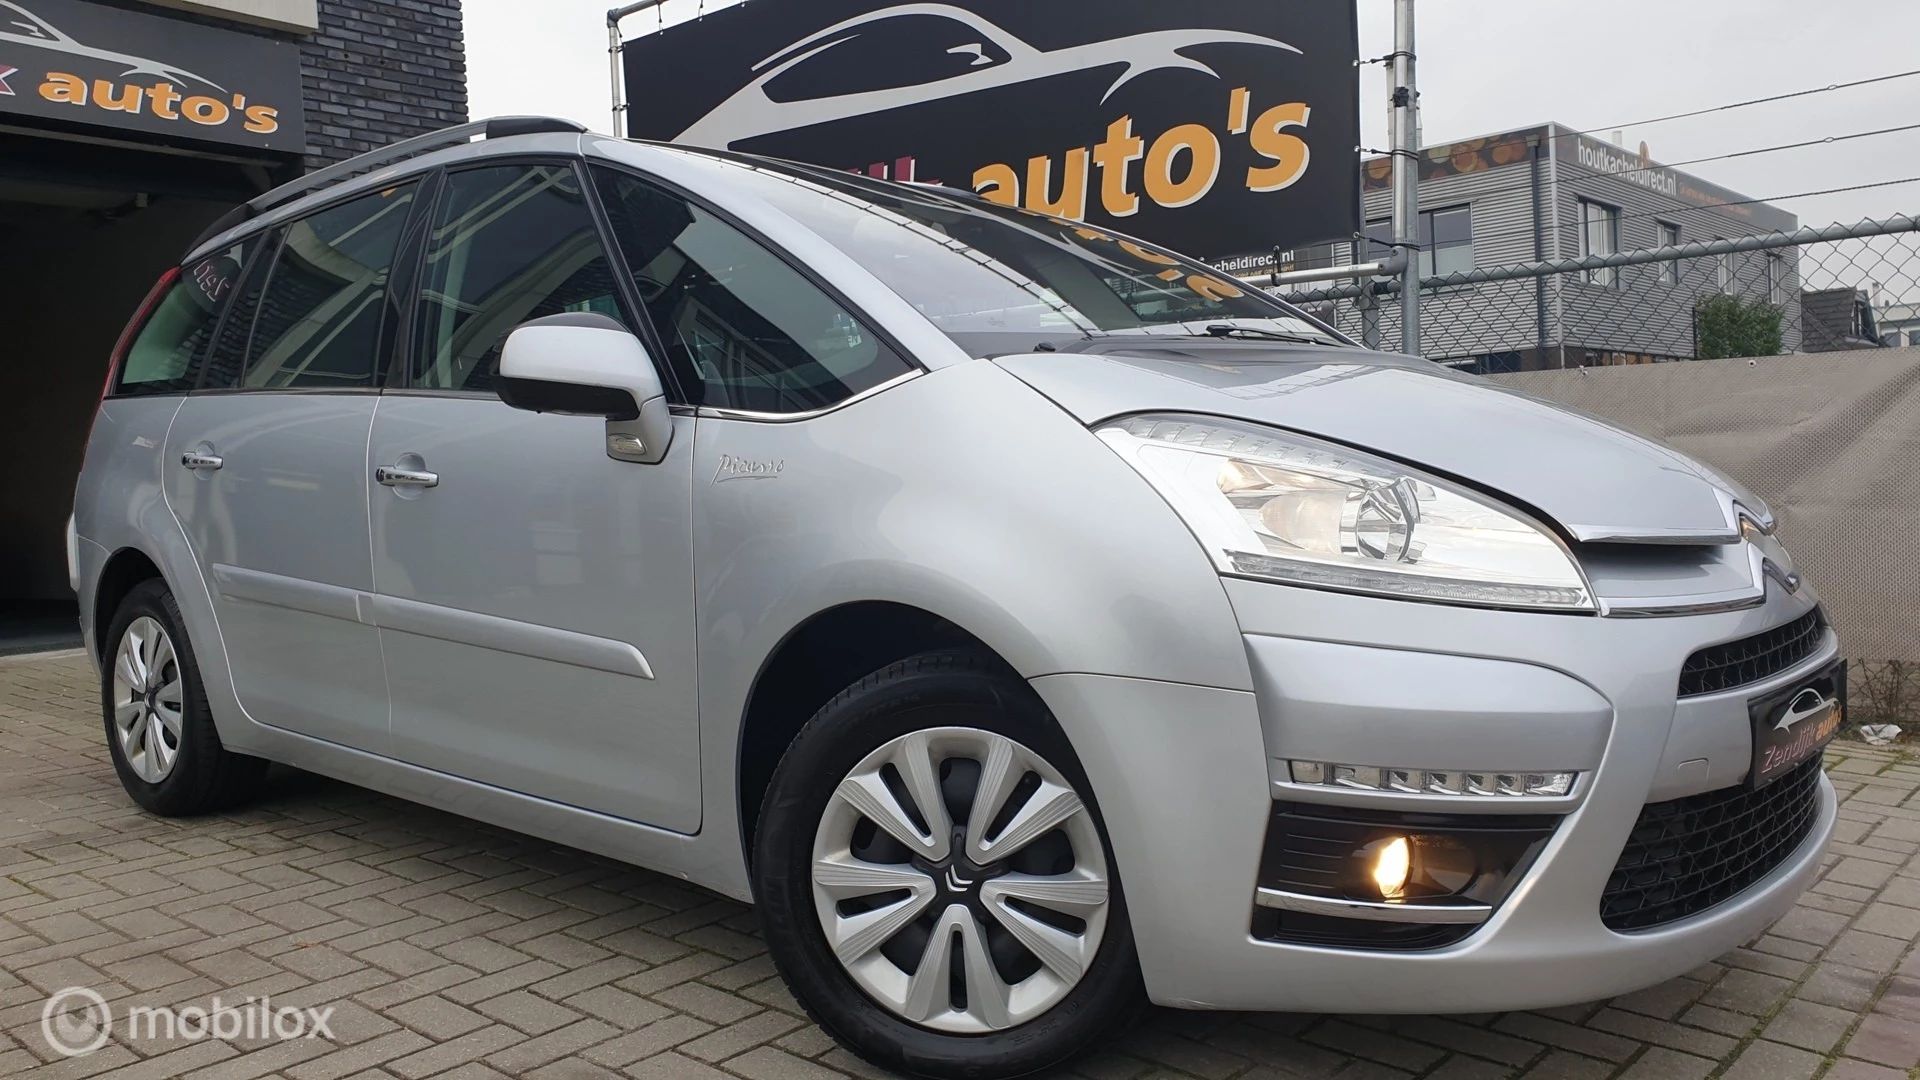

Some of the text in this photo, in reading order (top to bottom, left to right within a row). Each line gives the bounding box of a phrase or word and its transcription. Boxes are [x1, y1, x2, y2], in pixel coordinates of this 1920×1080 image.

[38, 71, 279, 134] auto's
[972, 87, 1311, 222] auto's
[1577, 137, 1677, 196] houtkacheldirect.nl
[710, 454, 784, 487] Picasso
